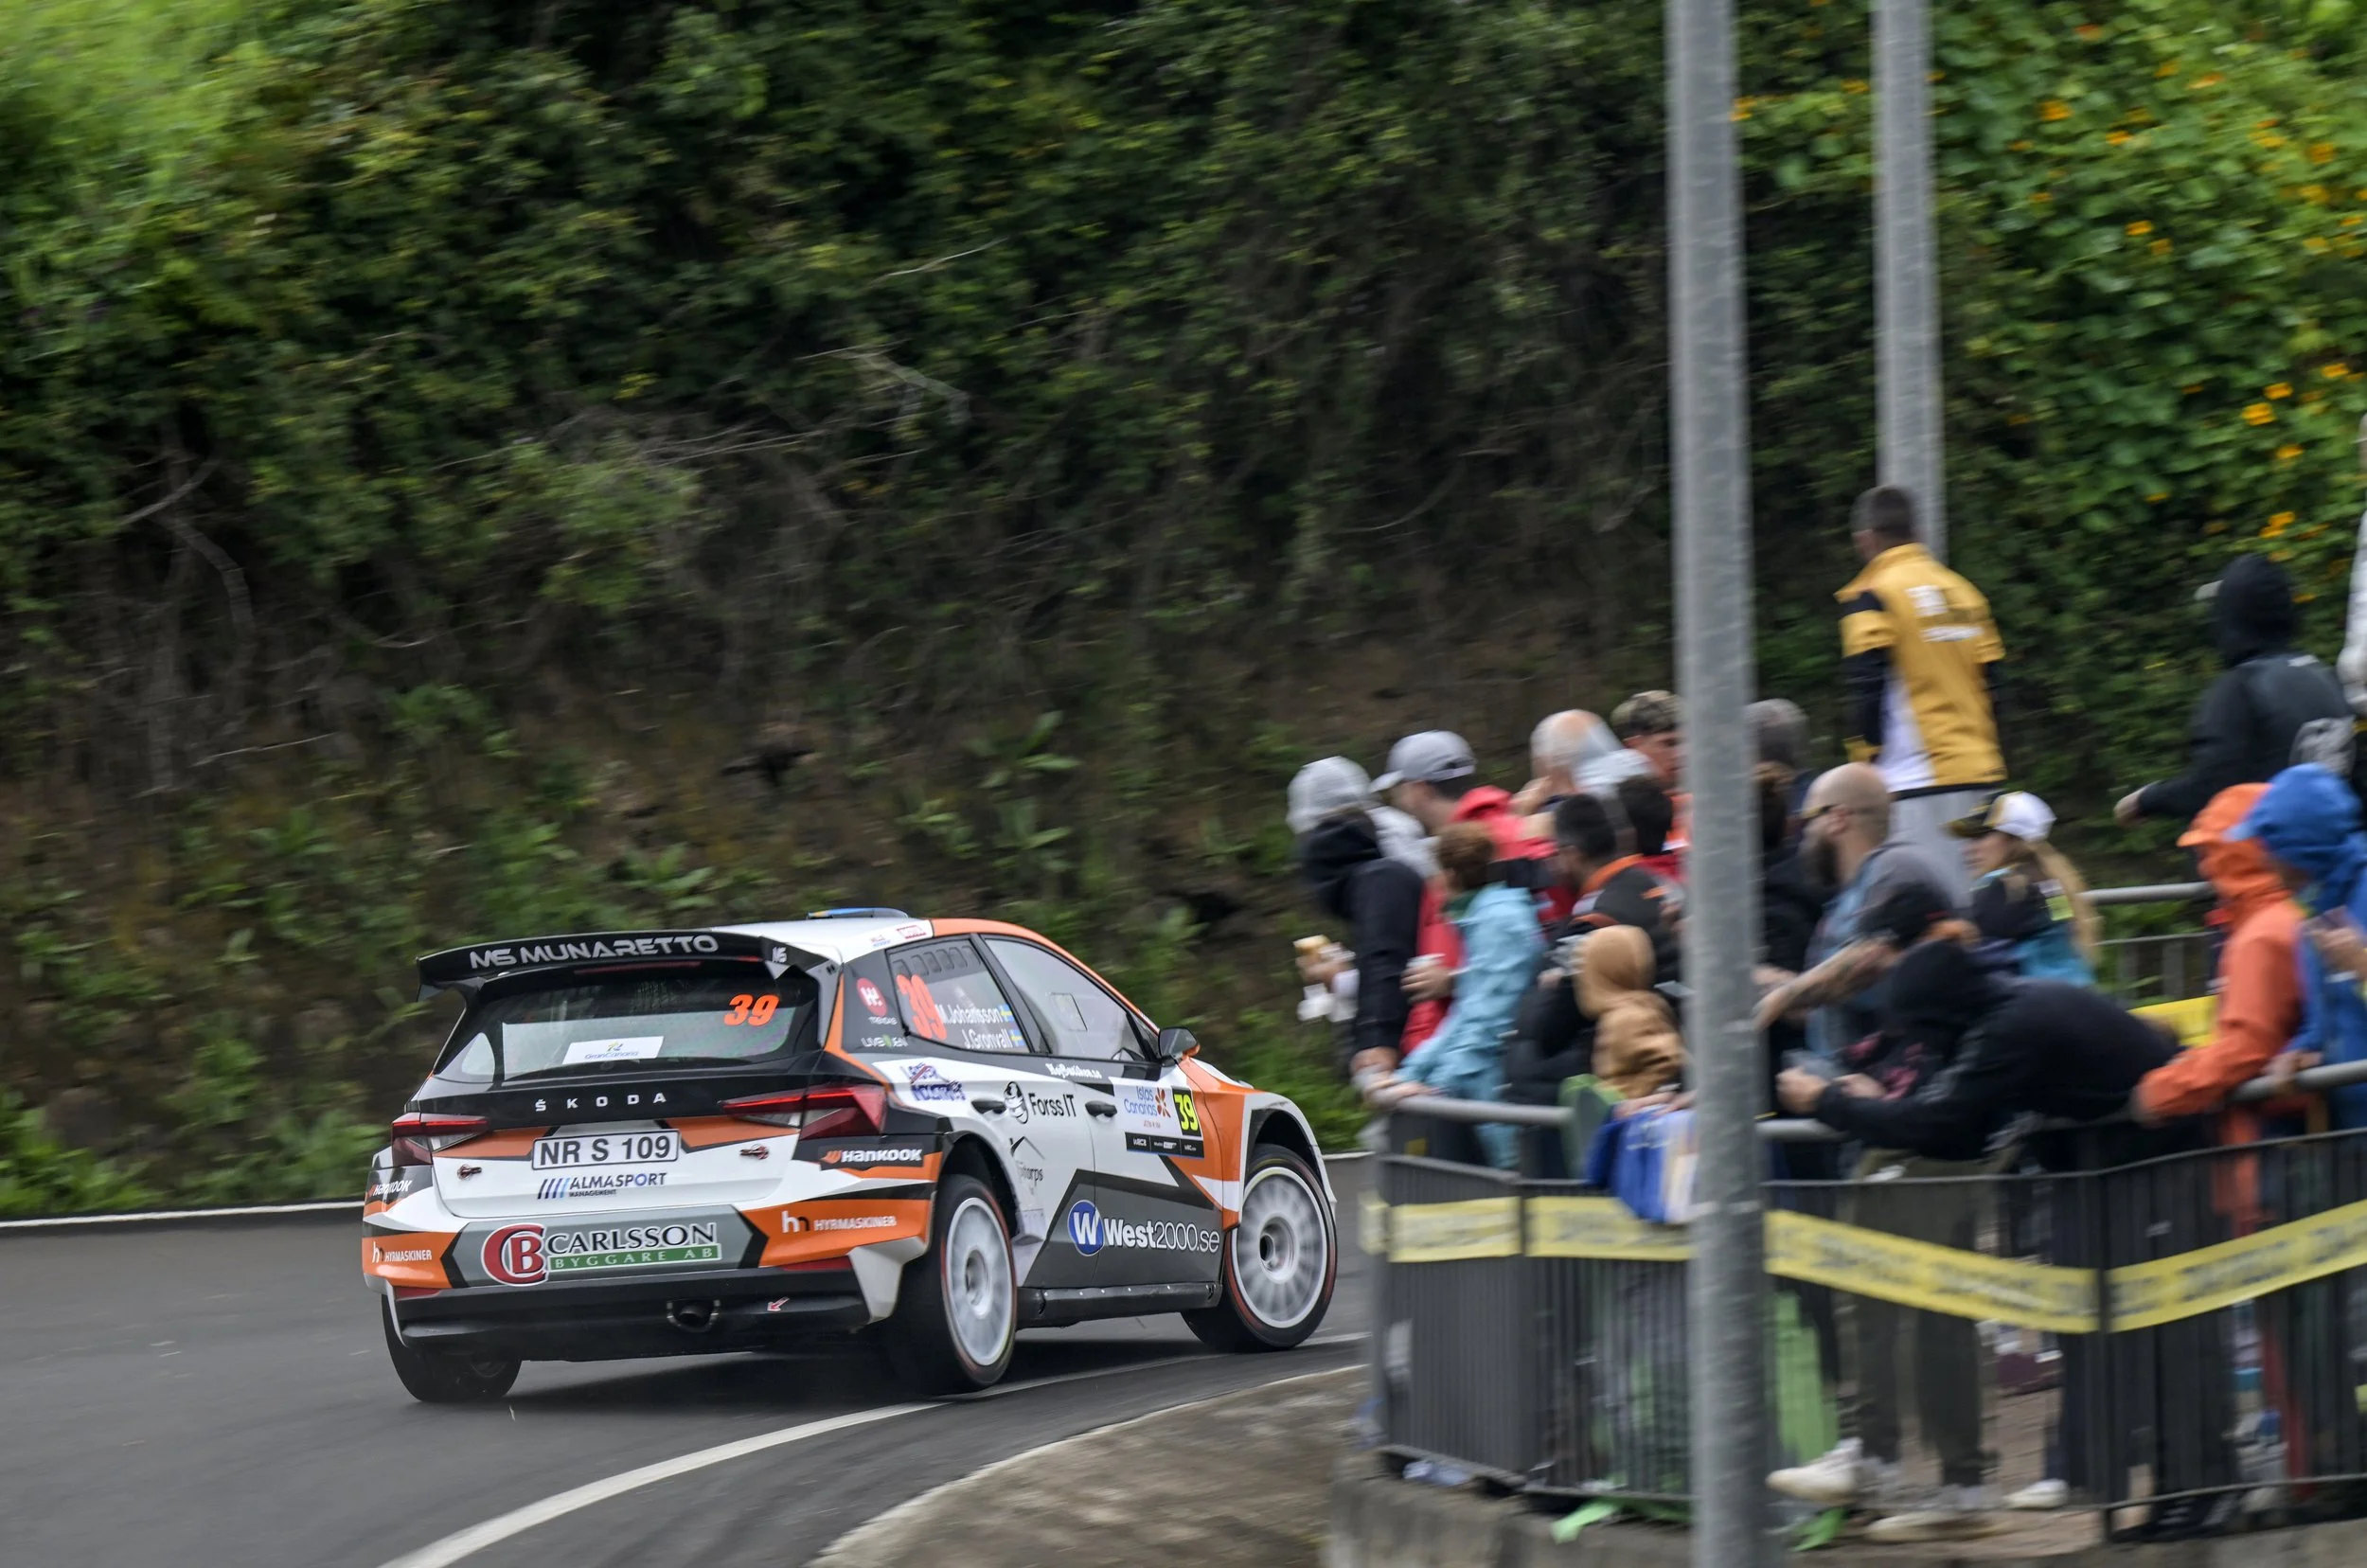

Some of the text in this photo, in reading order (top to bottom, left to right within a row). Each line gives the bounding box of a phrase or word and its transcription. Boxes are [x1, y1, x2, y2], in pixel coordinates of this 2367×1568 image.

[469, 934, 720, 971] MS MUNARETTO
[723, 993, 780, 1027] 39
[896, 973, 947, 1041] 39
[534, 1092, 667, 1113] ŠKODA
[1028, 1092, 1077, 1118] Forss IT
[1136, 1085, 1154, 1101] Islas
[1123, 1098, 1158, 1116] Canarias
[1173, 1094, 1199, 1131] 39
[540, 1135, 671, 1167] NR S 109
[568, 1188, 617, 1198] MANAGEMENT
[569, 1172, 667, 1190] ALMASPORT
[813, 1215, 898, 1232] HYRMASKINER
[1103, 1217, 1221, 1254] West2000.se
[547, 1222, 717, 1255] CARLSSON
[384, 1249, 433, 1262] HYRMASKINER
[554, 1247, 714, 1270] BYGGARE AB
